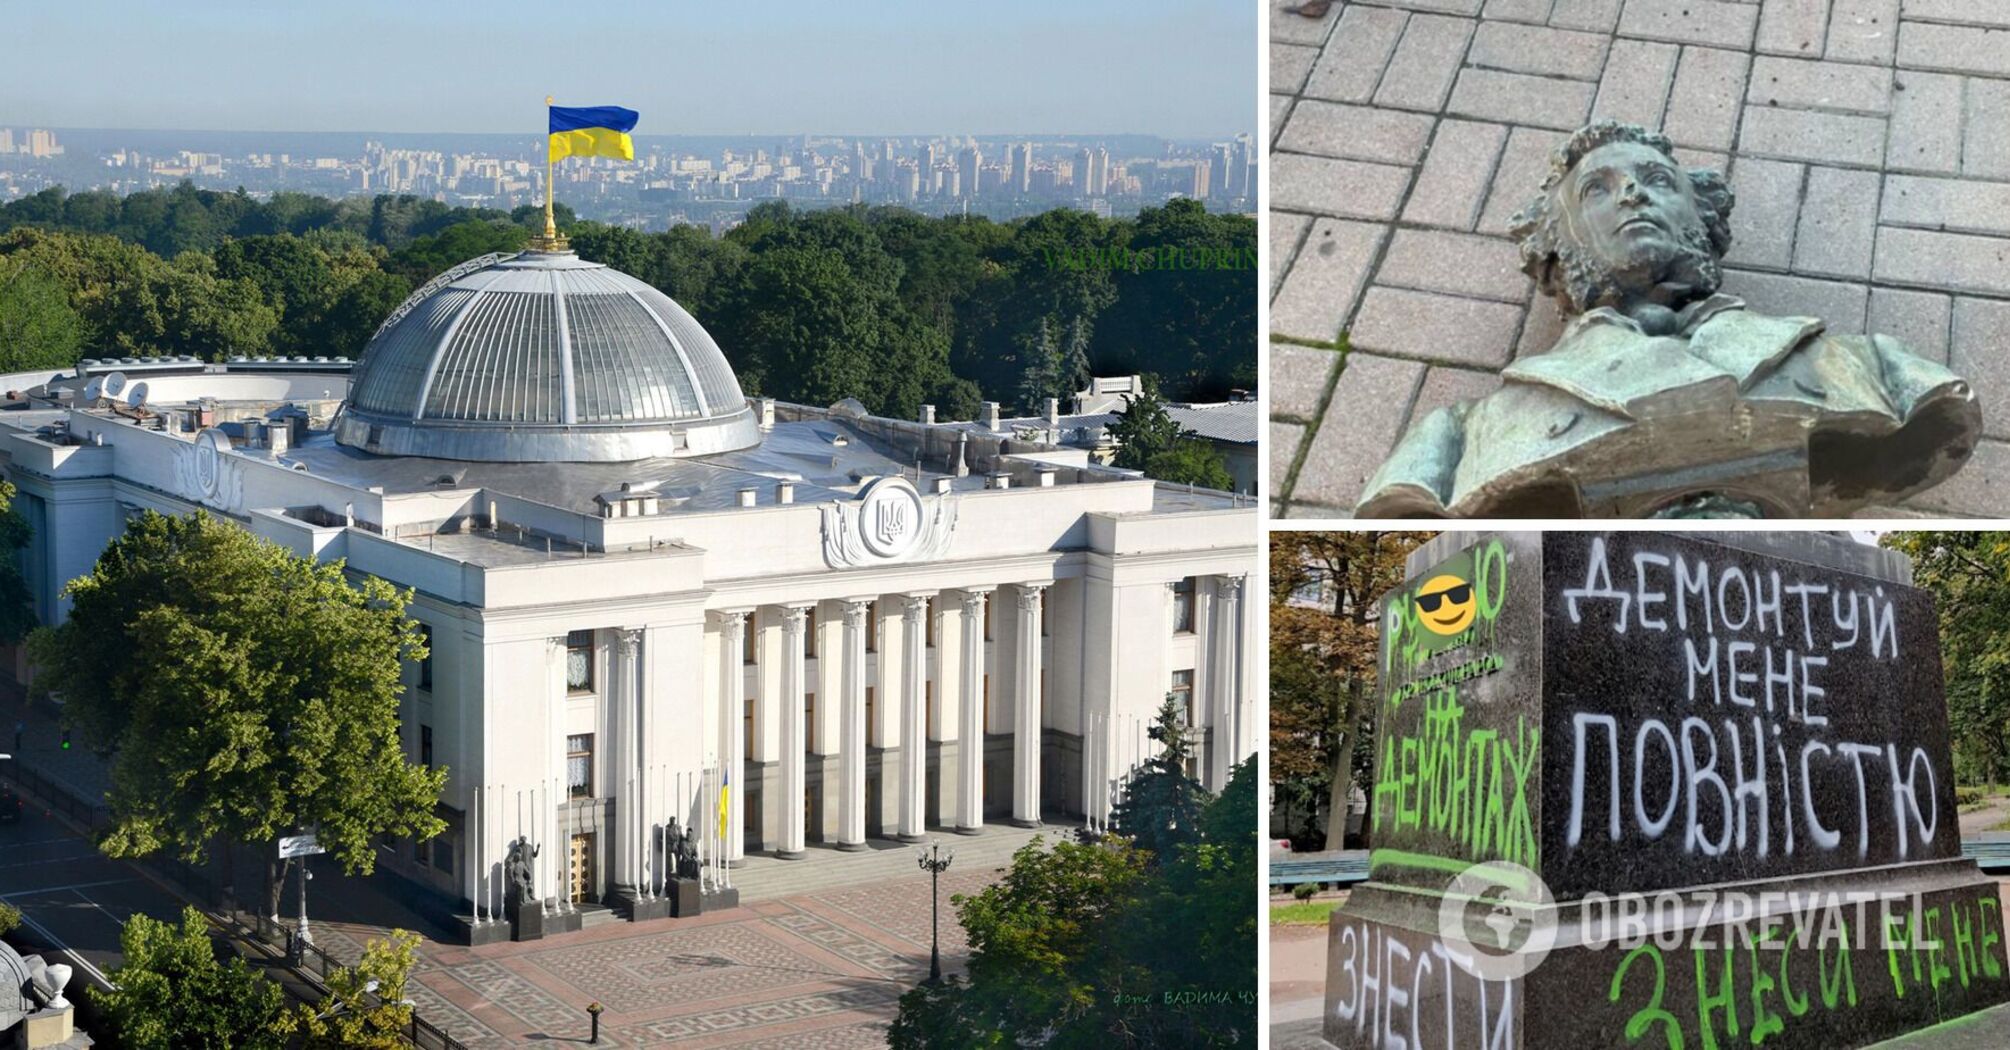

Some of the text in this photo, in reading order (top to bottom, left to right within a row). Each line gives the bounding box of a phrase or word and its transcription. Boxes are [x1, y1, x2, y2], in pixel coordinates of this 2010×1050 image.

[1387, 539, 1507, 672] РУЮ
[1562, 537, 1898, 659] ДЕМОНТУЙ
[1684, 636, 1828, 726] МЕНЕ
[1373, 713, 1540, 870] ДЕМОНТАЖ
[1337, 921, 1514, 1050] ЗНЕСТИ
[1884, 896, 2001, 1000] МЕНЕ
